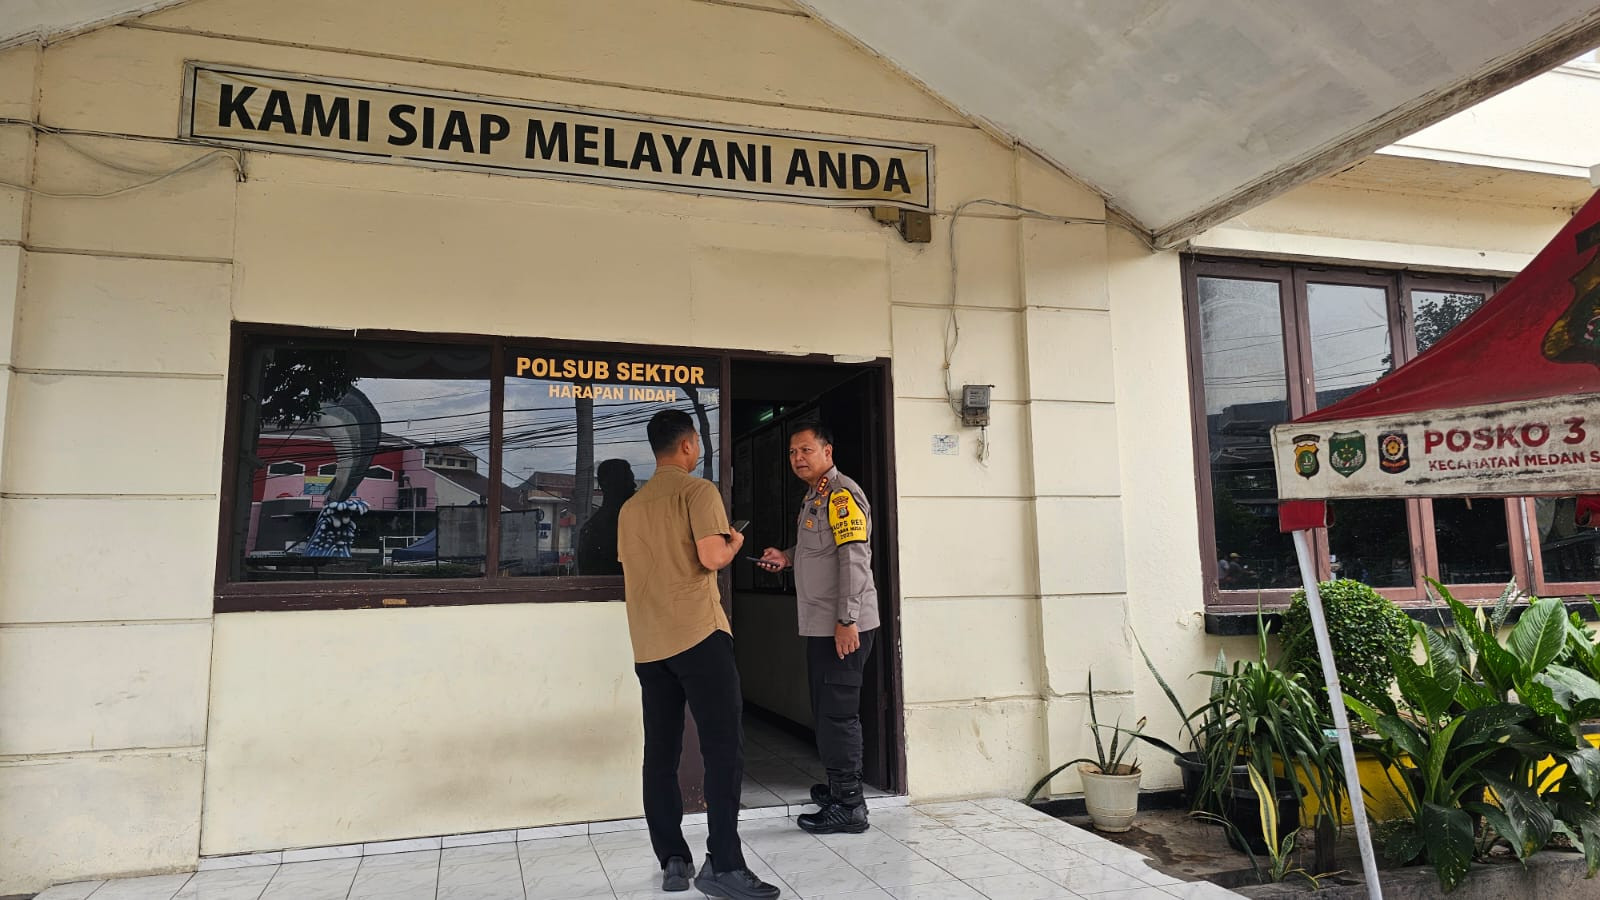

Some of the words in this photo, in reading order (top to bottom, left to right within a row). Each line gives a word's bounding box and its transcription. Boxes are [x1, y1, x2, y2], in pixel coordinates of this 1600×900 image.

[218, 84, 370, 142] KAMI
[388, 104, 510, 155] SIAP
[525, 119, 771, 183] MELAYANI
[785, 148, 911, 194] ANDA
[516, 357, 609, 380] POLSUB
[616, 362, 704, 384] SEKTOR
[549, 384, 624, 400] HARAPAN
[628, 388, 676, 403] INDAH
[1424, 424, 1550, 454] POSKO
[1563, 416, 1586, 445] 3
[1428, 456, 1520, 471] KECAMATAN
[1524, 451, 1586, 466] MEDAN
